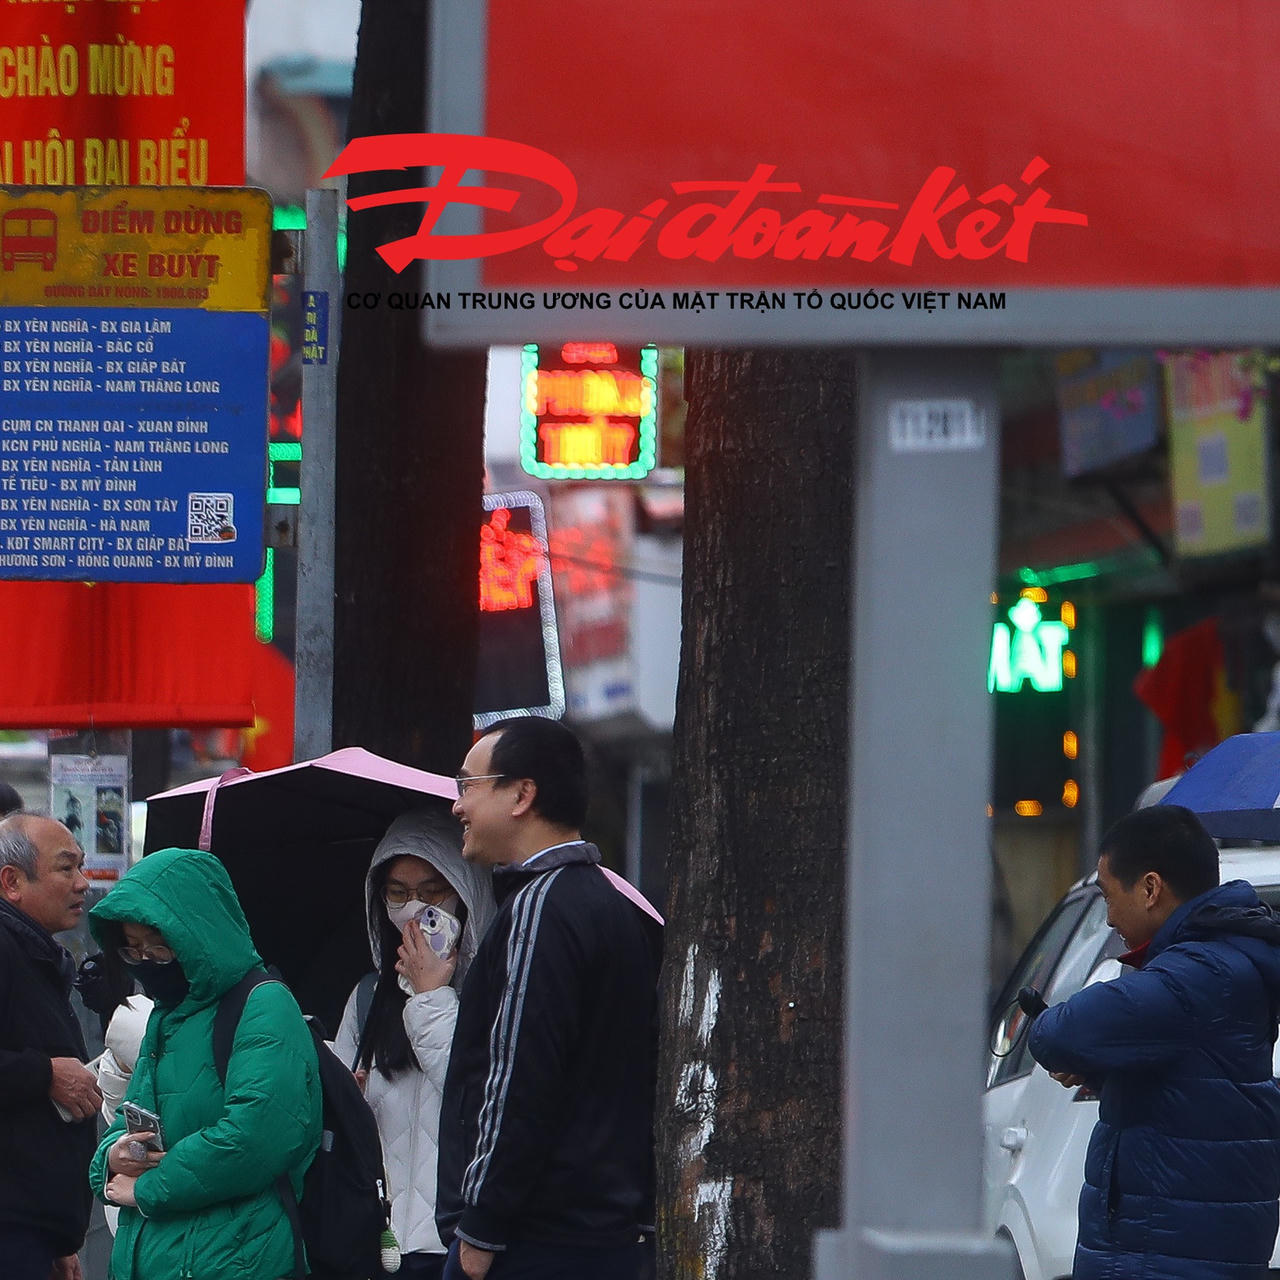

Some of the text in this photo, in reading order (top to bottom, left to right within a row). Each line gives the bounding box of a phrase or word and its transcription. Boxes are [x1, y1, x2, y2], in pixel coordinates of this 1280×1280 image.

[88, 33, 175, 96] MỪNG
[81, 199, 244, 235] ĐIỂM DỪNG
[102, 248, 221, 278] XE BUÝT
[4, 320, 21, 333] BX
[24, 317, 48, 333] YÊN
[51, 318, 89, 333] NGHĨA
[101, 320, 118, 333] BX
[121, 321, 142, 333] GIA
[145, 318, 171, 334] LÂM
[3, 340, 21, 353] BX
[24, 338, 50, 353] YÊN
[53, 338, 94, 353] NGHĨA
[3, 360, 21, 373] BX
[24, 358, 50, 373] YÊN
[53, 358, 94, 373] NGHĨA
[106, 361, 124, 373] BX
[127, 358, 158, 374] GIÁP
[161, 358, 186, 374] BÁT
[3, 379, 21, 392] BX
[24, 377, 50, 392] YÊN
[53, 377, 93, 392] NGHĨA
[105, 380, 136, 393] NAM
[186, 380, 220, 393] LONG
[2, 419, 31, 435] CỤM
[35, 419, 53, 432] CN
[57, 419, 99, 433] THANH
[103, 420, 125, 433] OAI
[2, 439, 29, 452] KCN
[62, 437, 102, 452] NGHĨA
[114, 440, 145, 453] NAM
[195, 441, 229, 454] LONG
[1, 459, 19, 472] BX
[22, 456, 48, 472] YÊN
[51, 457, 92, 472] NGHĨA
[20, 475, 48, 491] TIÊU
[60, 479, 78, 492] BX
[105, 476, 137, 492] ĐÌNH
[0, 498, 18, 511] BX
[21, 496, 47, 511] YÊN
[50, 496, 91, 511] NGHĨA
[103, 499, 121, 512] BX
[124, 498, 151, 512] SƠN
[154, 497, 178, 512] TÂY
[0, 518, 17, 531] BX
[20, 516, 45, 531] YÊN
[48, 516, 88, 531] NGHĨA
[100, 515, 117, 532] HÀ
[120, 519, 150, 532] NAM
[32, 536, 76, 551] SMART
[78, 537, 105, 551] CITY
[116, 537, 133, 551] BX
[136, 535, 165, 551] GIÁP
[168, 534, 190, 551] BÁT
[41, 553, 66, 567] SƠN
[113, 555, 153, 569] QUANG
[164, 555, 180, 568] BX
[204, 552, 234, 568] ĐÌNH
